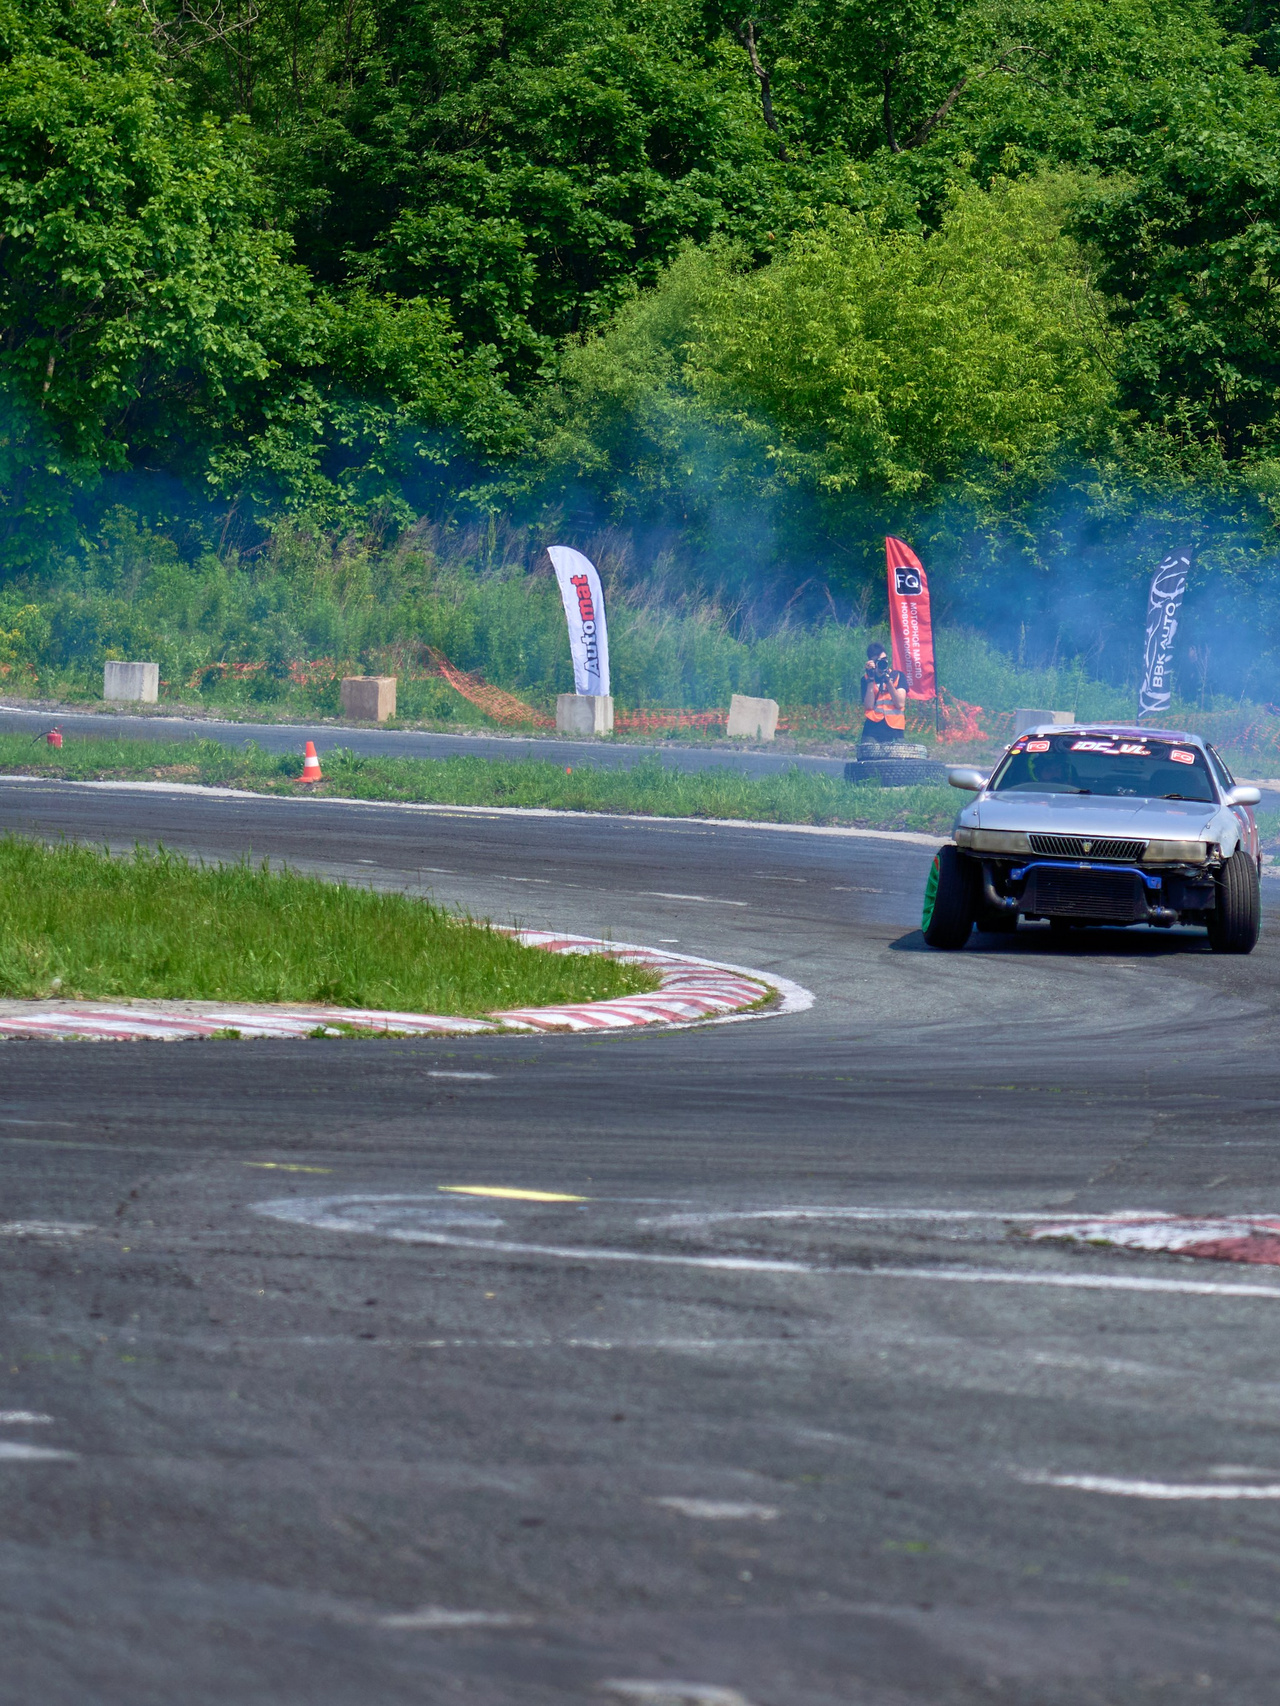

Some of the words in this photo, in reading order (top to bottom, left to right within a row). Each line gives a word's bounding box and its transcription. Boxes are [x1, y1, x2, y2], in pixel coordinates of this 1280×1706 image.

[896, 574, 919, 589] FQ
[569, 574, 600, 678] Automat
[901, 601, 910, 635] НОВОГО
[910, 601, 920, 647] МОТОРНОЕ
[912, 648, 923, 679] МАСЛО
[1152, 653, 1166, 688] BBK
[1160, 602, 1176, 650] AUTO
